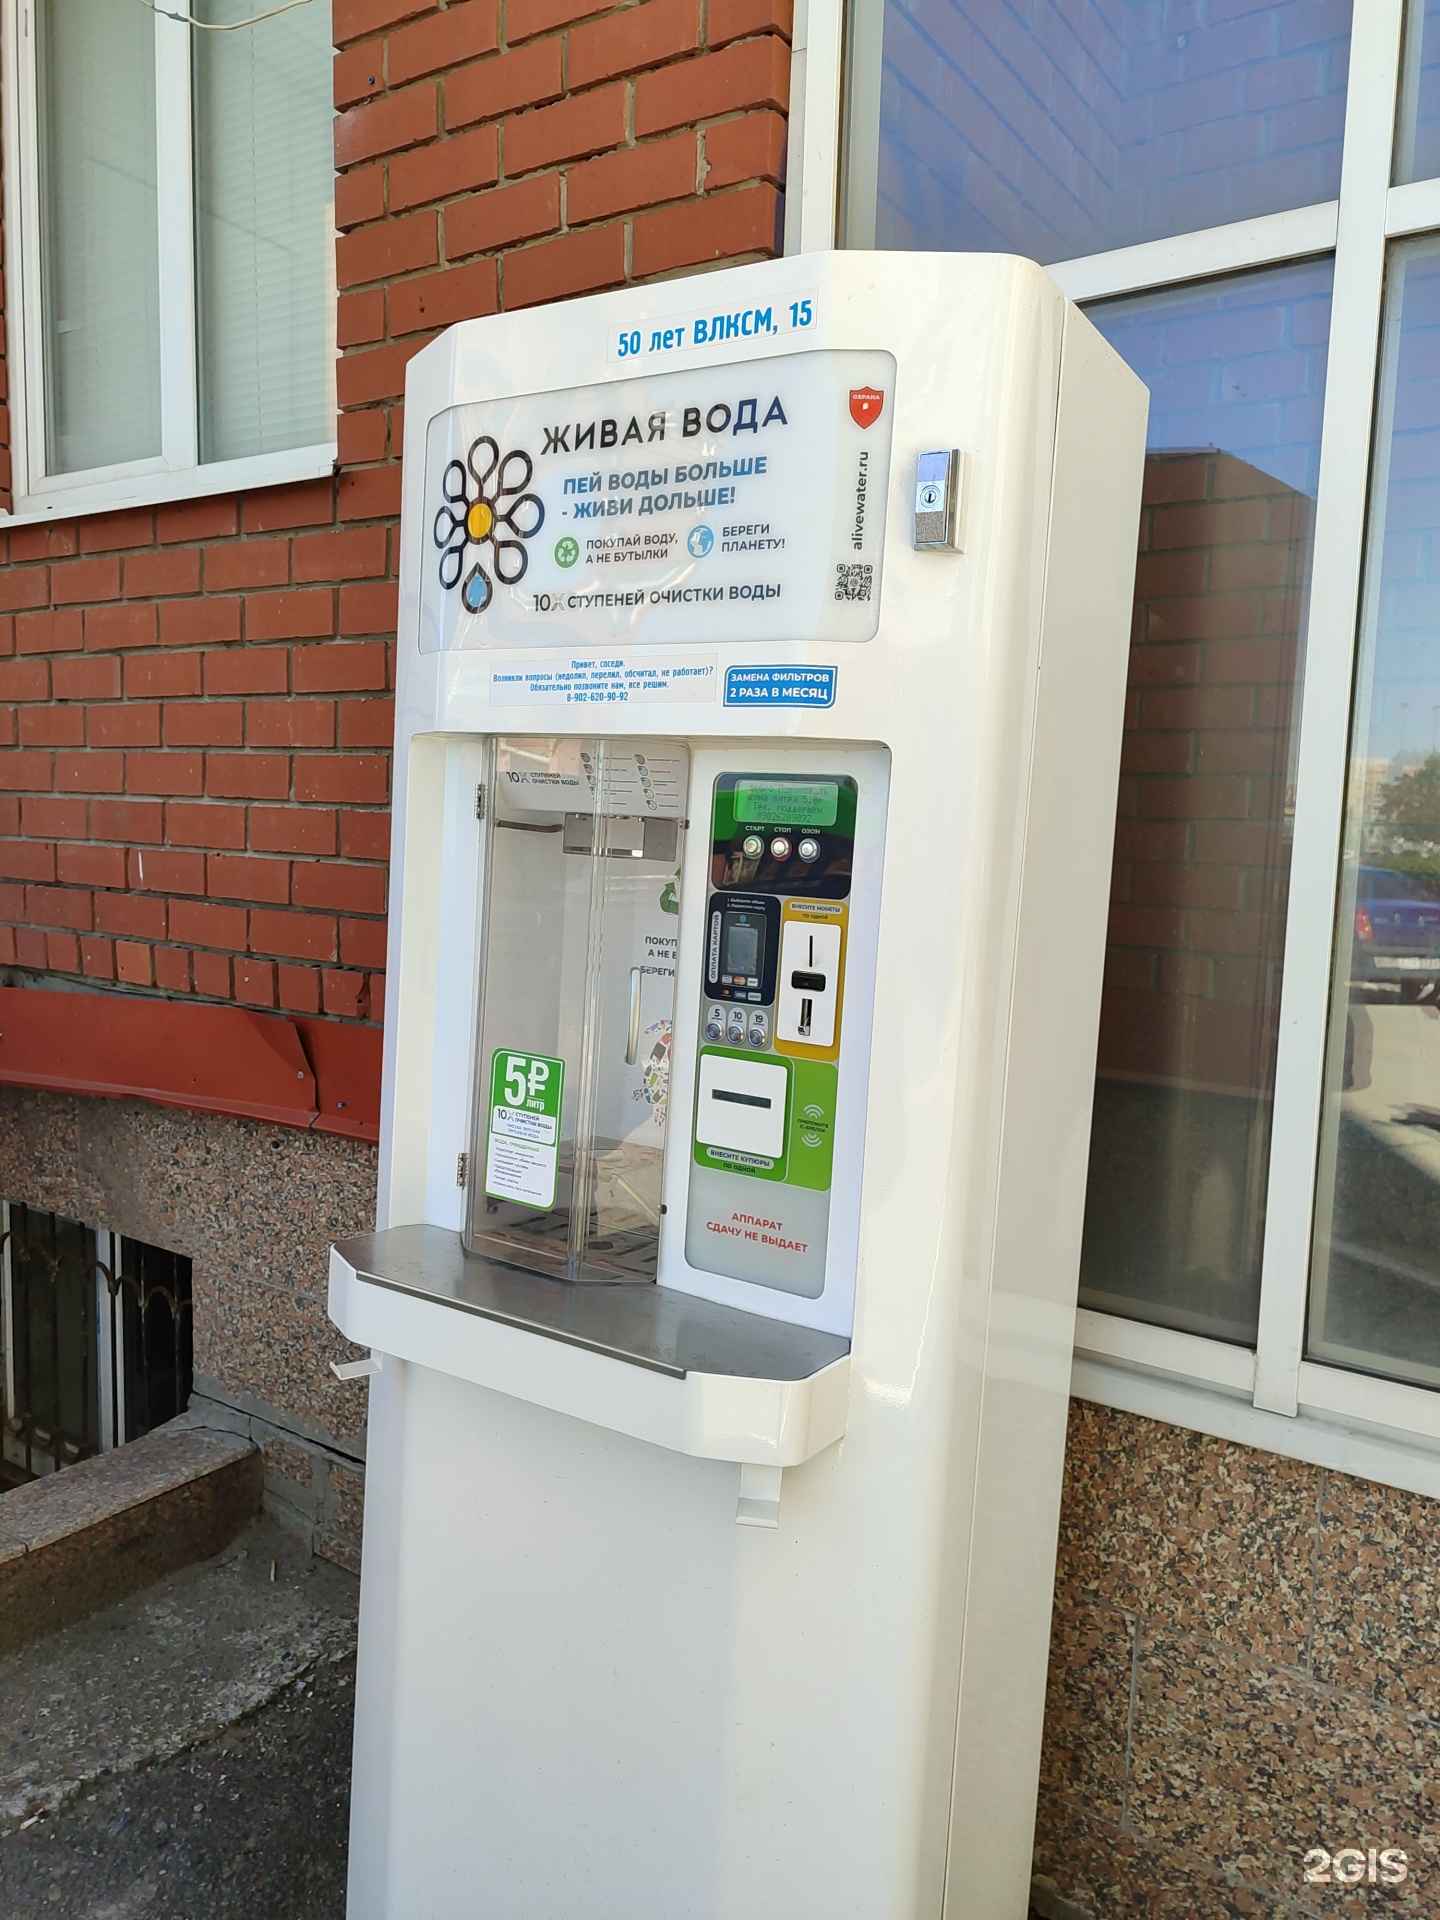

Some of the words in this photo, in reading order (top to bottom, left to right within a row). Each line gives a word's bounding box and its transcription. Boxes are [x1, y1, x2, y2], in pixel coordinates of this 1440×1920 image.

[617, 330, 641, 357] 50
[648, 327, 685, 352] лет
[693, 307, 778, 344] ВЛКСМ,
[789, 300, 812, 327] 15
[540, 411, 666, 455] ЖИВАЯ
[682, 395, 788, 438] ВОДА
[563, 471, 602, 495] ПЕЙ
[608, 467, 668, 491] ВОДЫ
[674, 456, 768, 483] БОЛЬШЕ
[573, 498, 633, 519] ЖИВИ
[638, 486, 736, 516] ДОЛЬШЕ!
[851, 451, 869, 550] alivewater.ru
[722, 523, 770, 537] БЕРЕГИ
[586, 535, 641, 550] ПОКУПАЙ
[644, 532, 679, 546] ВОДУ,
[721, 538, 785, 553] ПЛАНЕТУ!
[585, 554, 593, 564] А
[596, 553, 611, 564] НЕ
[613, 549, 669, 563] БУТЫЛКИ
[567, 590, 645, 609] СТУПЕНЕЙ
[650, 586, 724, 605] ОЧИСТКИ
[729, 583, 781, 600] ВОДЫ
[730, 673, 769, 682] ЗАМЕНА
[771, 673, 830, 683] ФИЛЬТРОВ
[566, 692, 629, 702] 8-902-620-90-92
[730, 688, 737, 697] 2
[739, 688, 768, 697] РАЗА
[771, 688, 779, 697] В
[782, 688, 828, 700] МЕСЯЦ
[648, 949, 655, 957] А
[657, 950, 670, 959] НЕ
[714, 1009, 720, 1017] 5
[733, 1011, 742, 1020] 10
[731, 1212, 783, 1232] АППАРАТ
[706, 1221, 743, 1237] СДАЧУ
[744, 1230, 758, 1241] НЕ
[761, 1234, 809, 1253] ВЫДАЕТ
